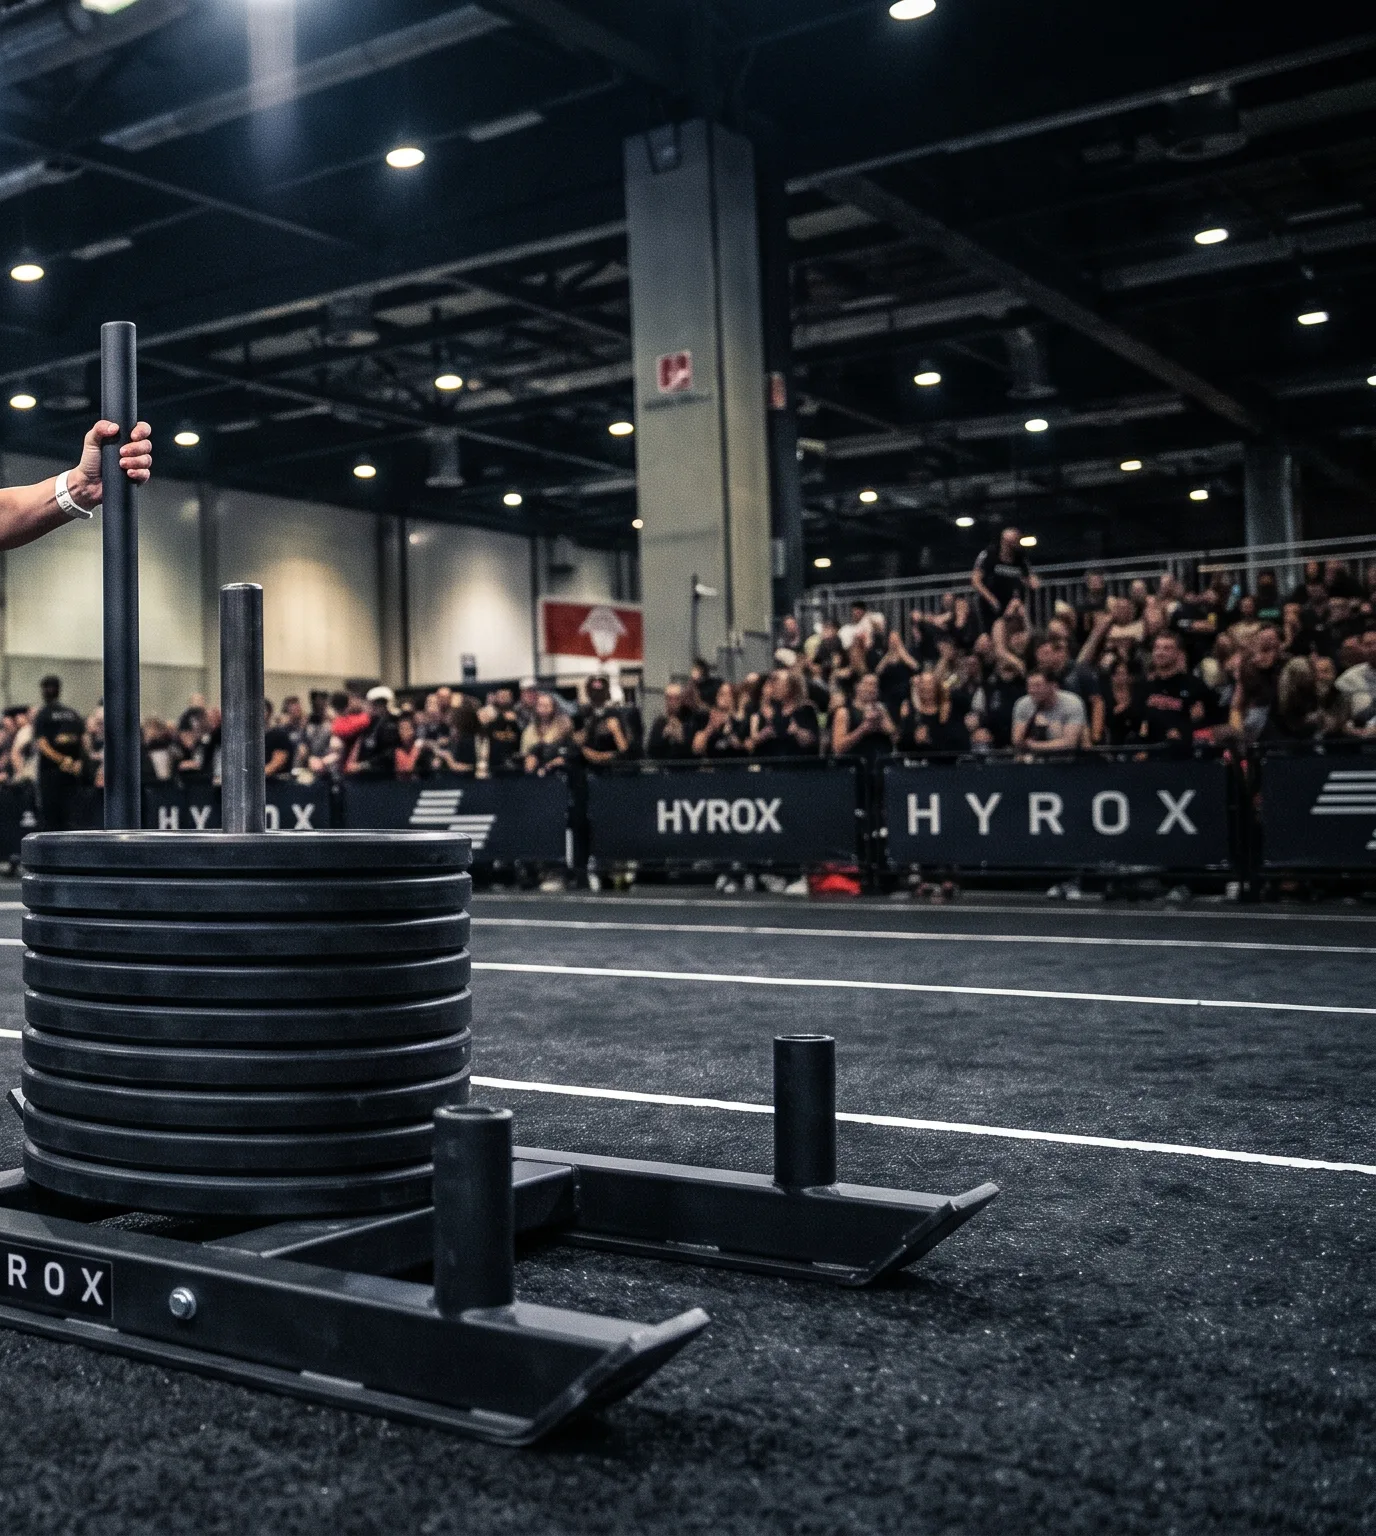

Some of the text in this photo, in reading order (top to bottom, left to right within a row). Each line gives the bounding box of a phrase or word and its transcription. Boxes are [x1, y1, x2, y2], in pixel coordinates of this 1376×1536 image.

[158, 803, 315, 830] HYOX
[657, 798, 782, 834] HYROX
[907, 790, 1197, 835] HYROX
